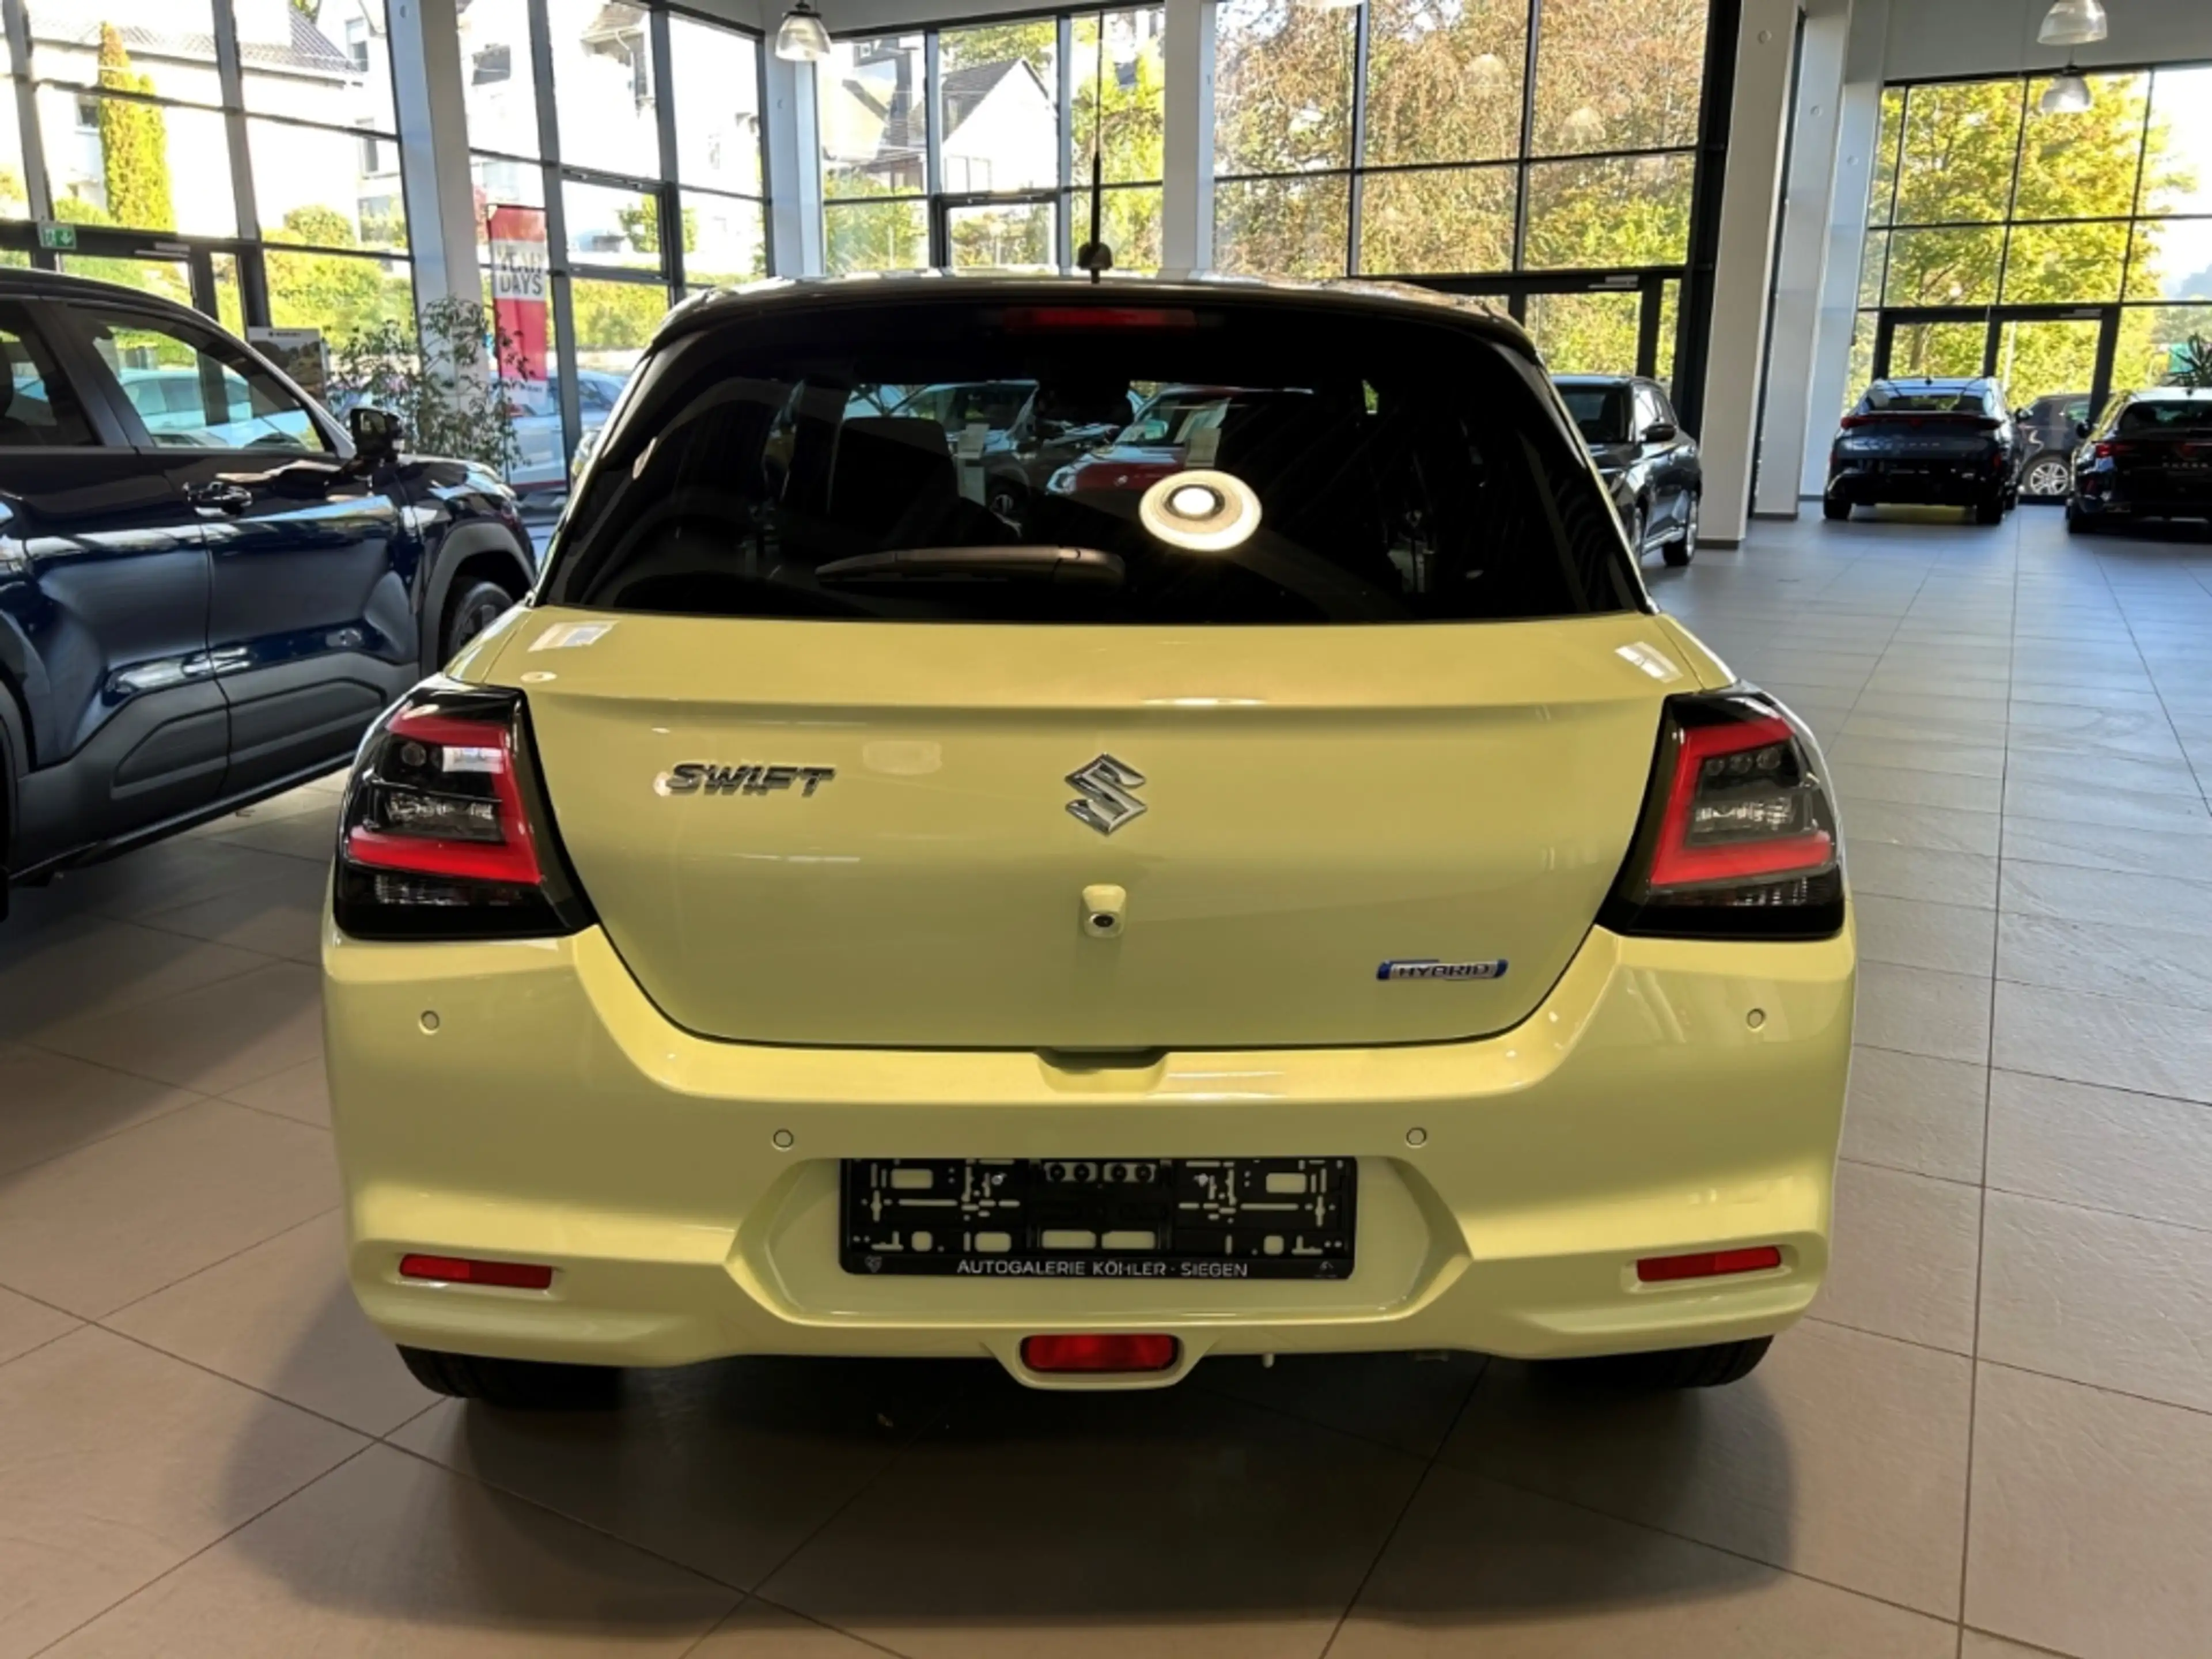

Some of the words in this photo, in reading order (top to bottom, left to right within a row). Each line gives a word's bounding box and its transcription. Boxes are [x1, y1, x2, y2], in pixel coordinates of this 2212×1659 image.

[500, 274, 543, 296] DAYS
[666, 763, 836, 797] SWIFT
[1399, 964, 1490, 979] HYBRID
[957, 1259, 1085, 1275] AUTOGALERIE
[1093, 1260, 1167, 1276] KÖHLER
[1180, 1262, 1248, 1277] SIEGEN
